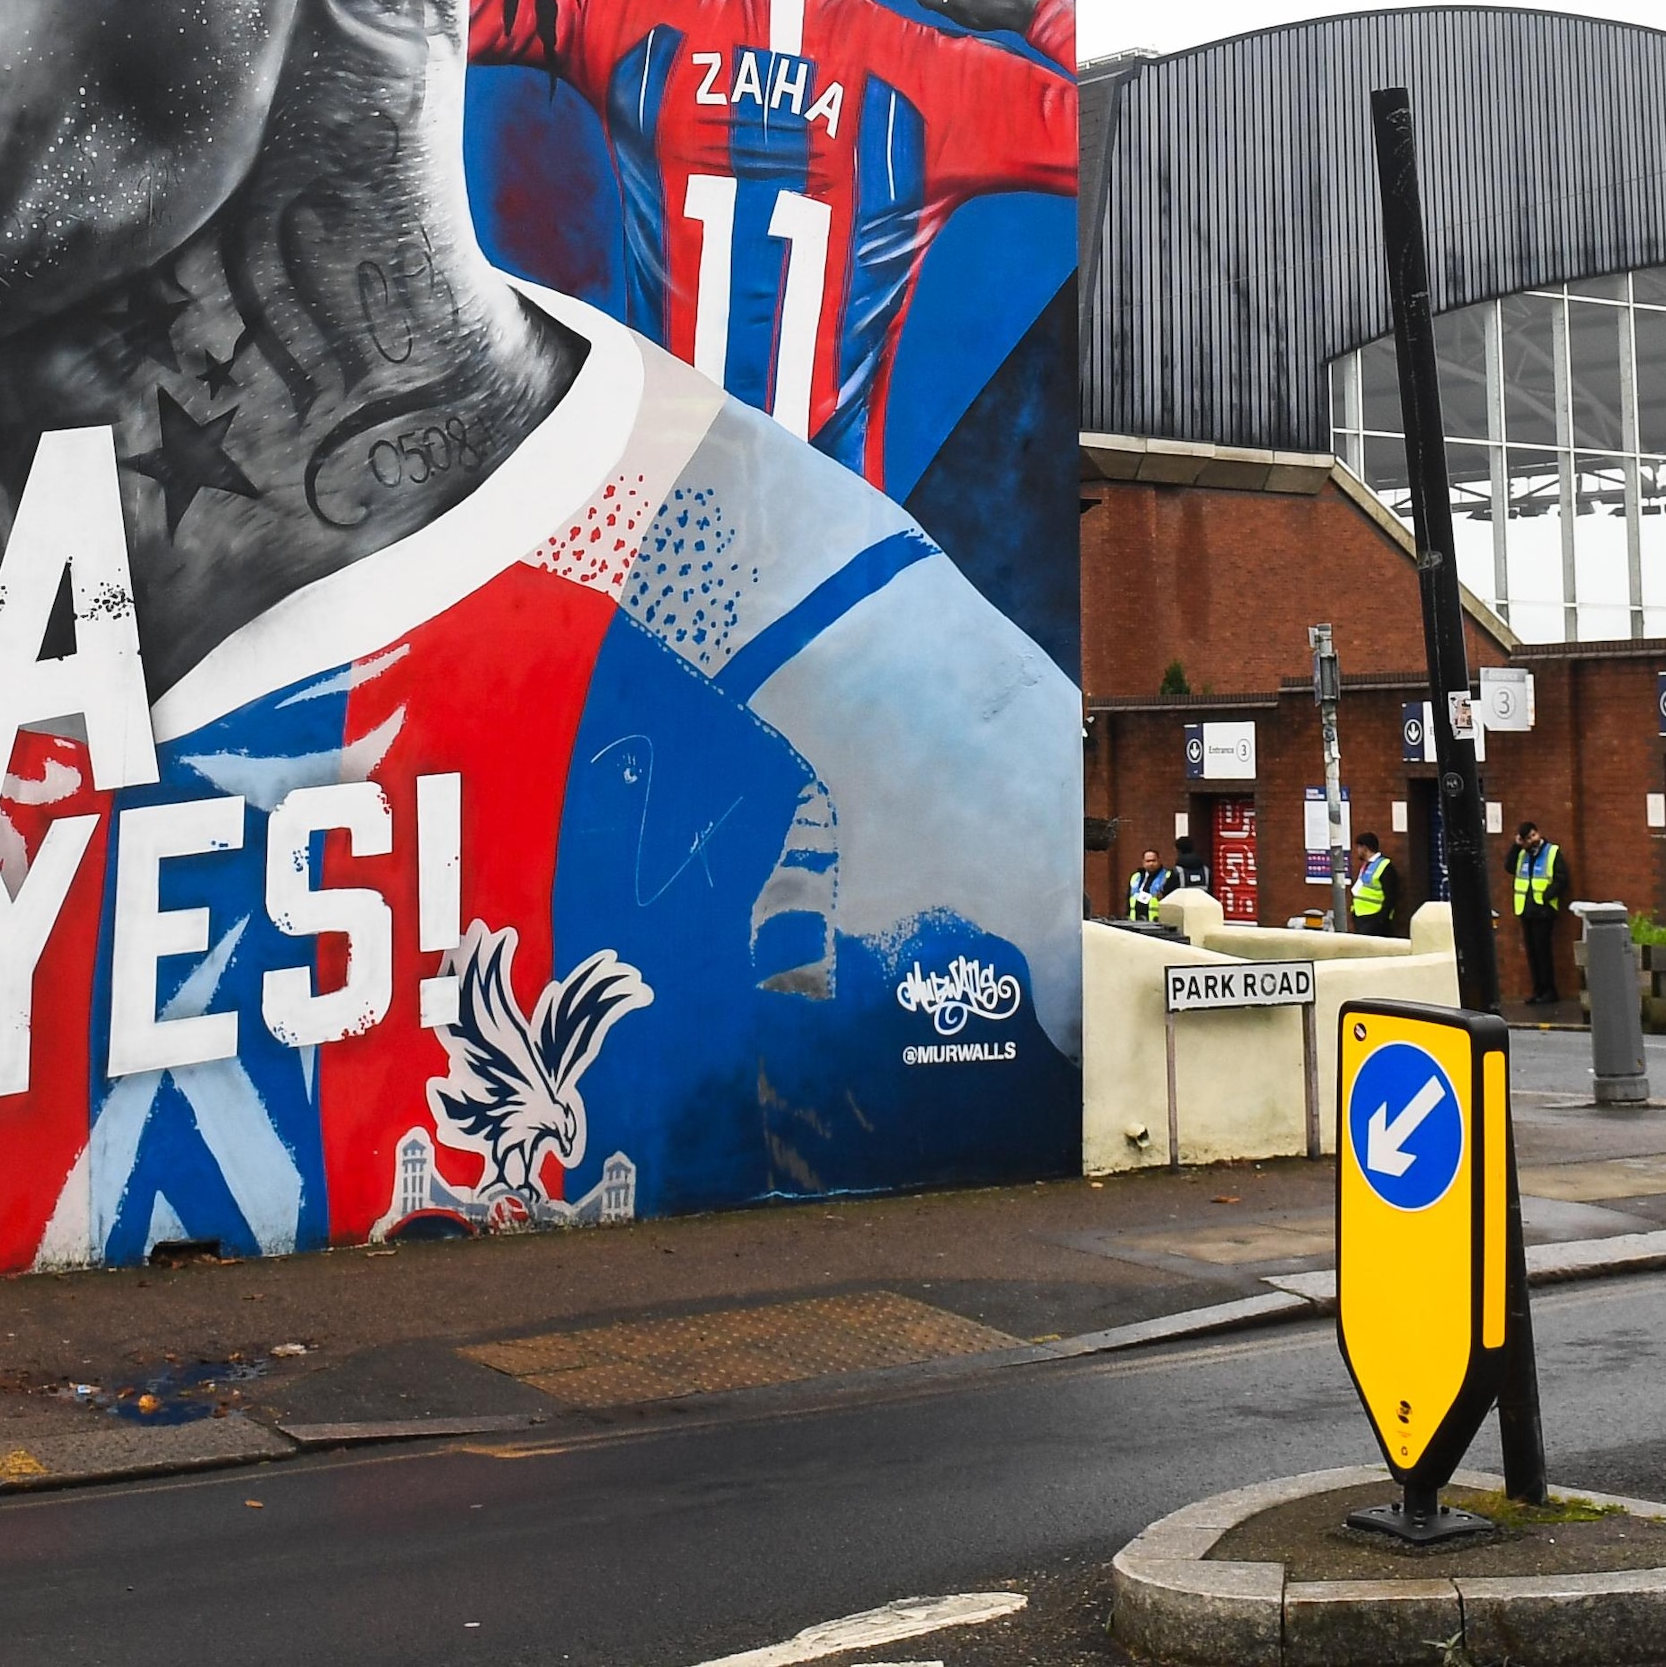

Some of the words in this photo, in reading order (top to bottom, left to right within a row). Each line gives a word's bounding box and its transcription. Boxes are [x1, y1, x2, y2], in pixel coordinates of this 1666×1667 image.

[692, 51, 844, 138] ZAHA
[683, 174, 832, 443] 11
[1498, 691, 1510, 715] 3
[1208, 745, 1235, 755] Entrance
[1241, 744, 1248, 757] 3
[1172, 974, 1235, 1001] PARK
[1243, 970, 1311, 997] ROAD
[902, 1041, 1017, 1066] @MURWALLS
